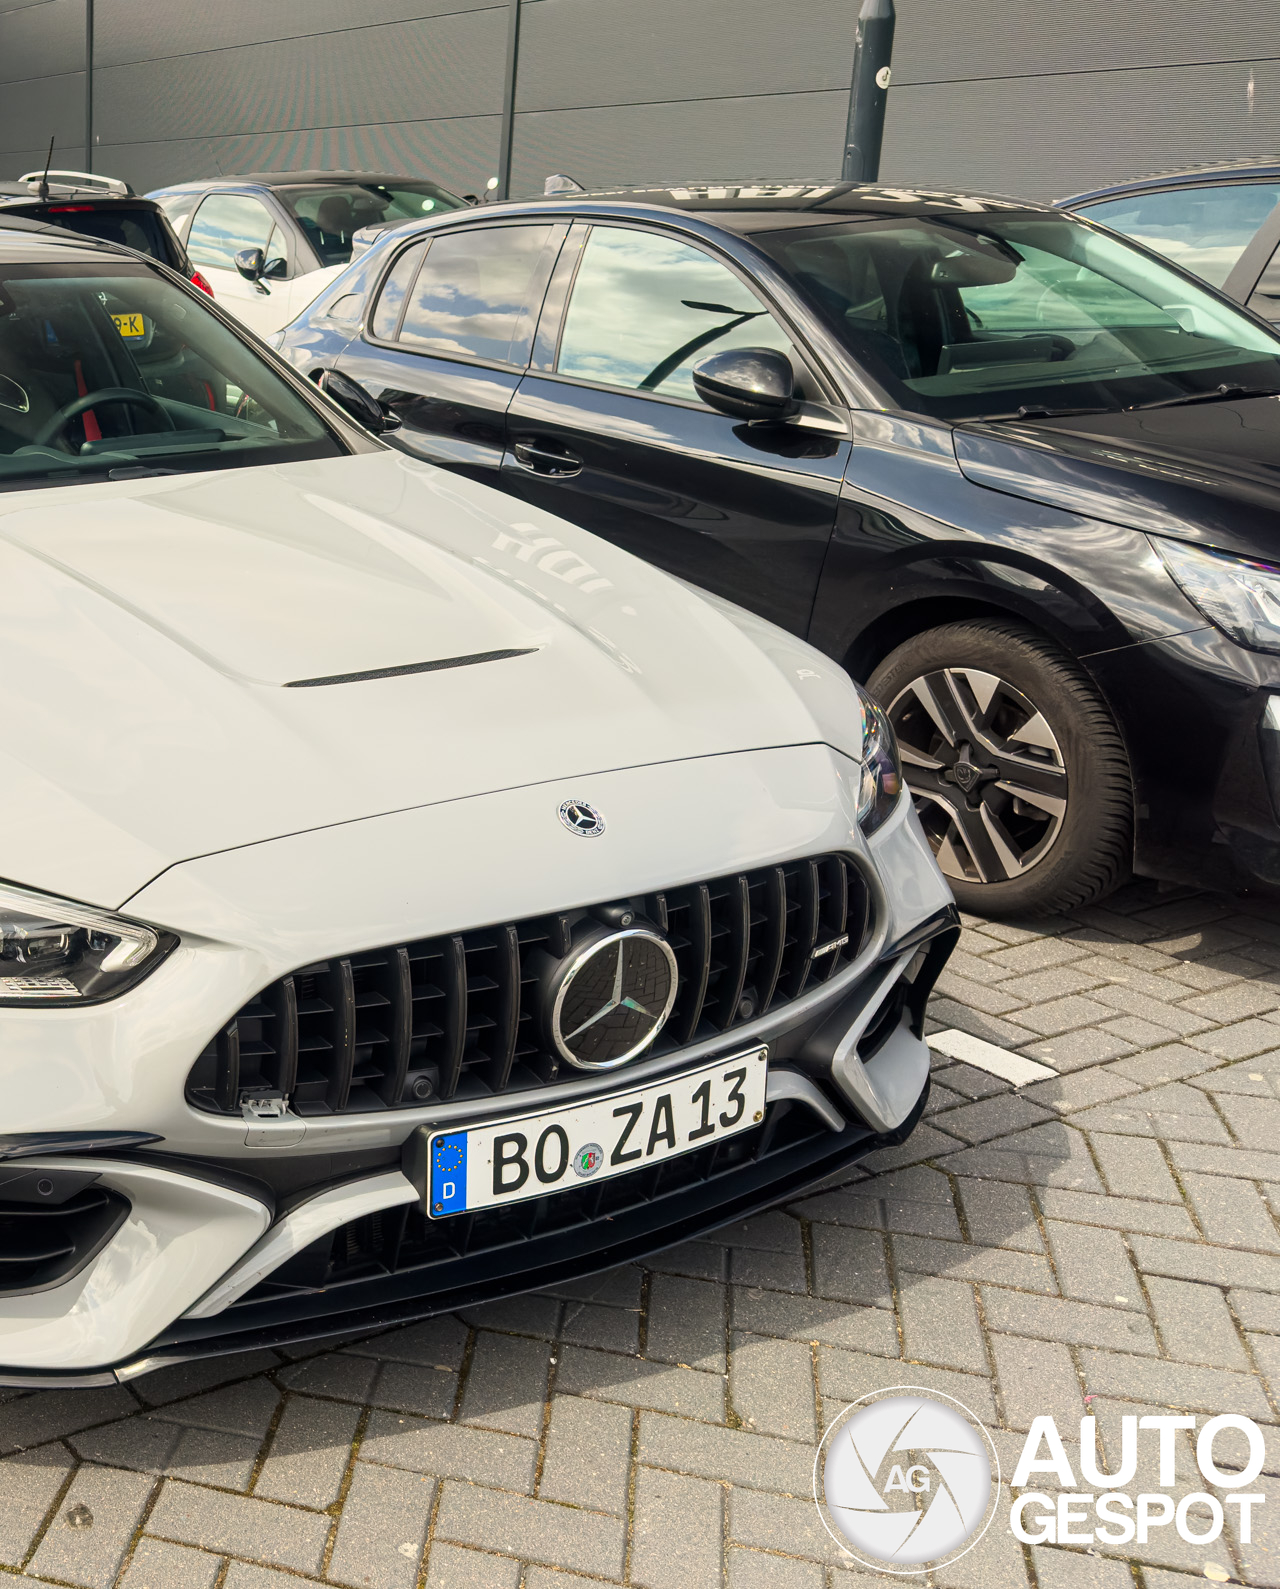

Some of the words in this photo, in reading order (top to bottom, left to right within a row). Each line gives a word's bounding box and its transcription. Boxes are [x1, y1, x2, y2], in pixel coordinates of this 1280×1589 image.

[493, 1124, 569, 1195] BO
[610, 1093, 676, 1166] ZA
[688, 1067, 747, 1142] 13
[442, 1181, 456, 1200] D
